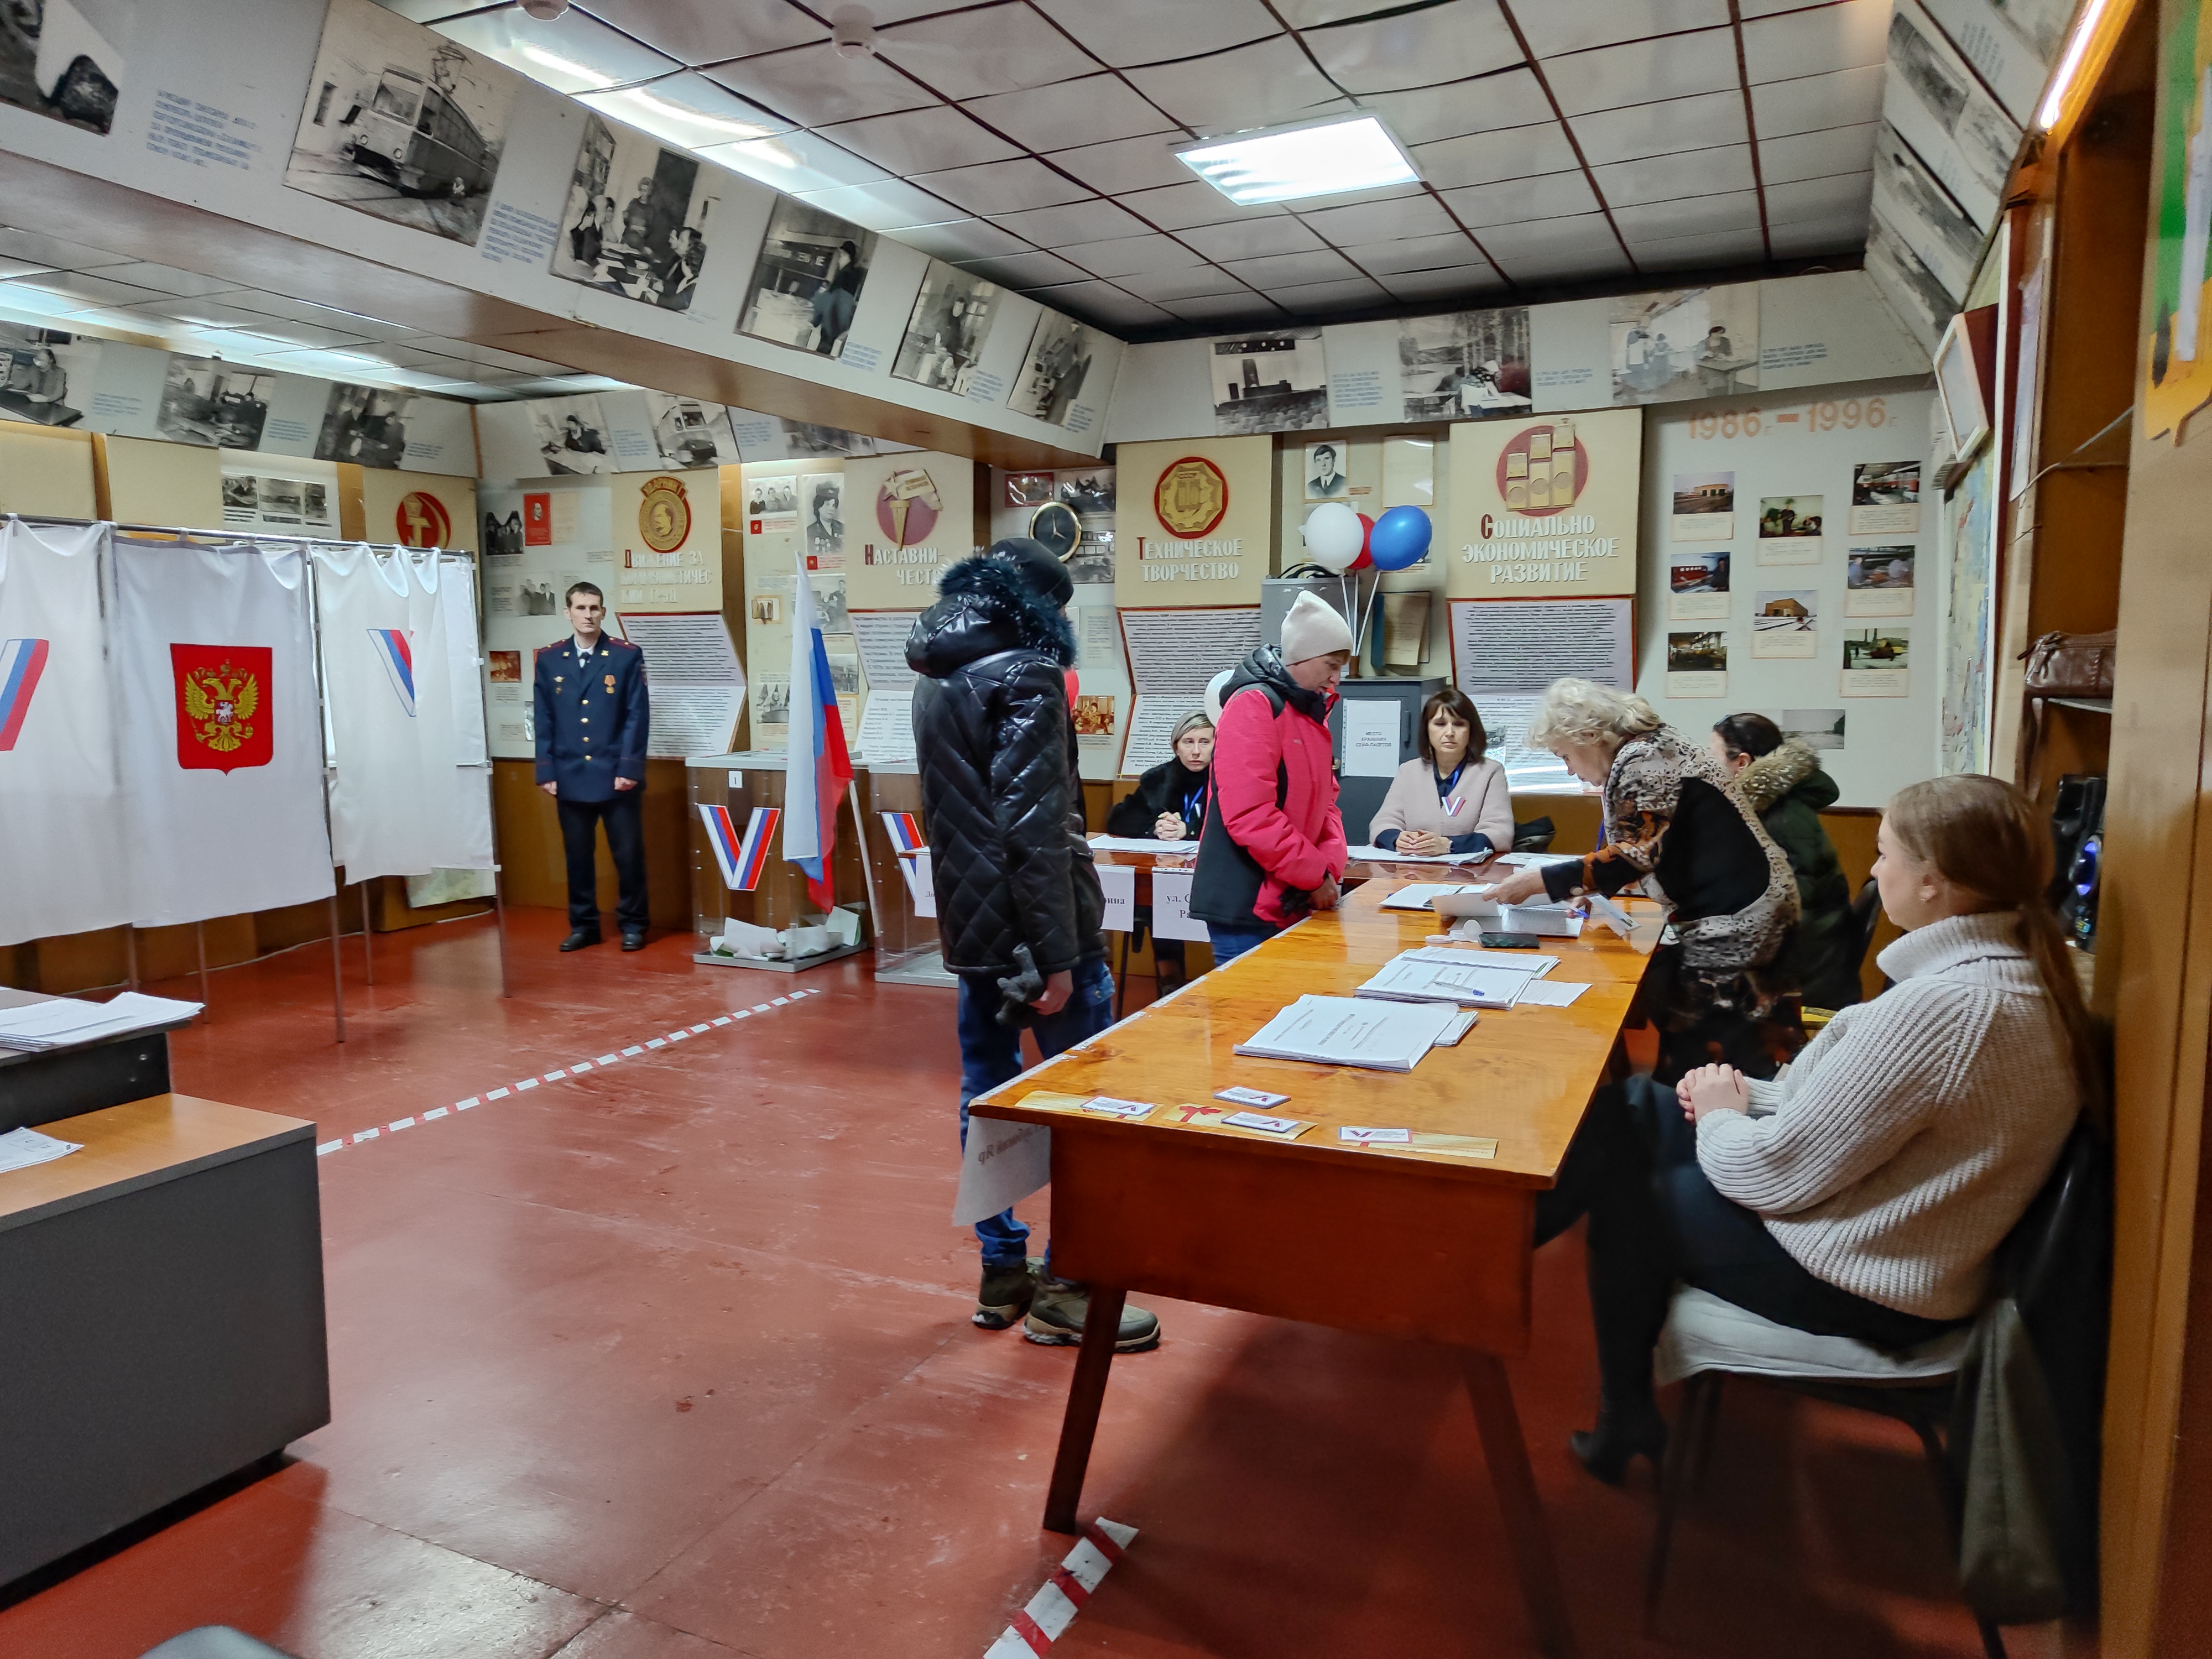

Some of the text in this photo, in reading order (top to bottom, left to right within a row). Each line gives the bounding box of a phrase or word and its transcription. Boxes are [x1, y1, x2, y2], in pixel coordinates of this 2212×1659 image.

[1689, 407, 1761, 440] 1986
[1808, 397, 1885, 432] 1996
[1480, 514, 1595, 540] СОЦИАЛЬНО
[688, 550, 705, 565] ЗА
[864, 544, 945, 565] НАСТАВНИ-
[1136, 536, 1243, 560] ТЕХНИЧЕСКОЕ
[1462, 538, 1619, 562] ЭКОНОМИЧЕСКОЕ
[896, 568, 941, 585] ЧЕСТВ
[1141, 562, 1239, 582] ТВОРЧЕСТВО
[1491, 561, 1588, 583] РАЗВИТИЕ
[734, 776, 738, 785] 1
